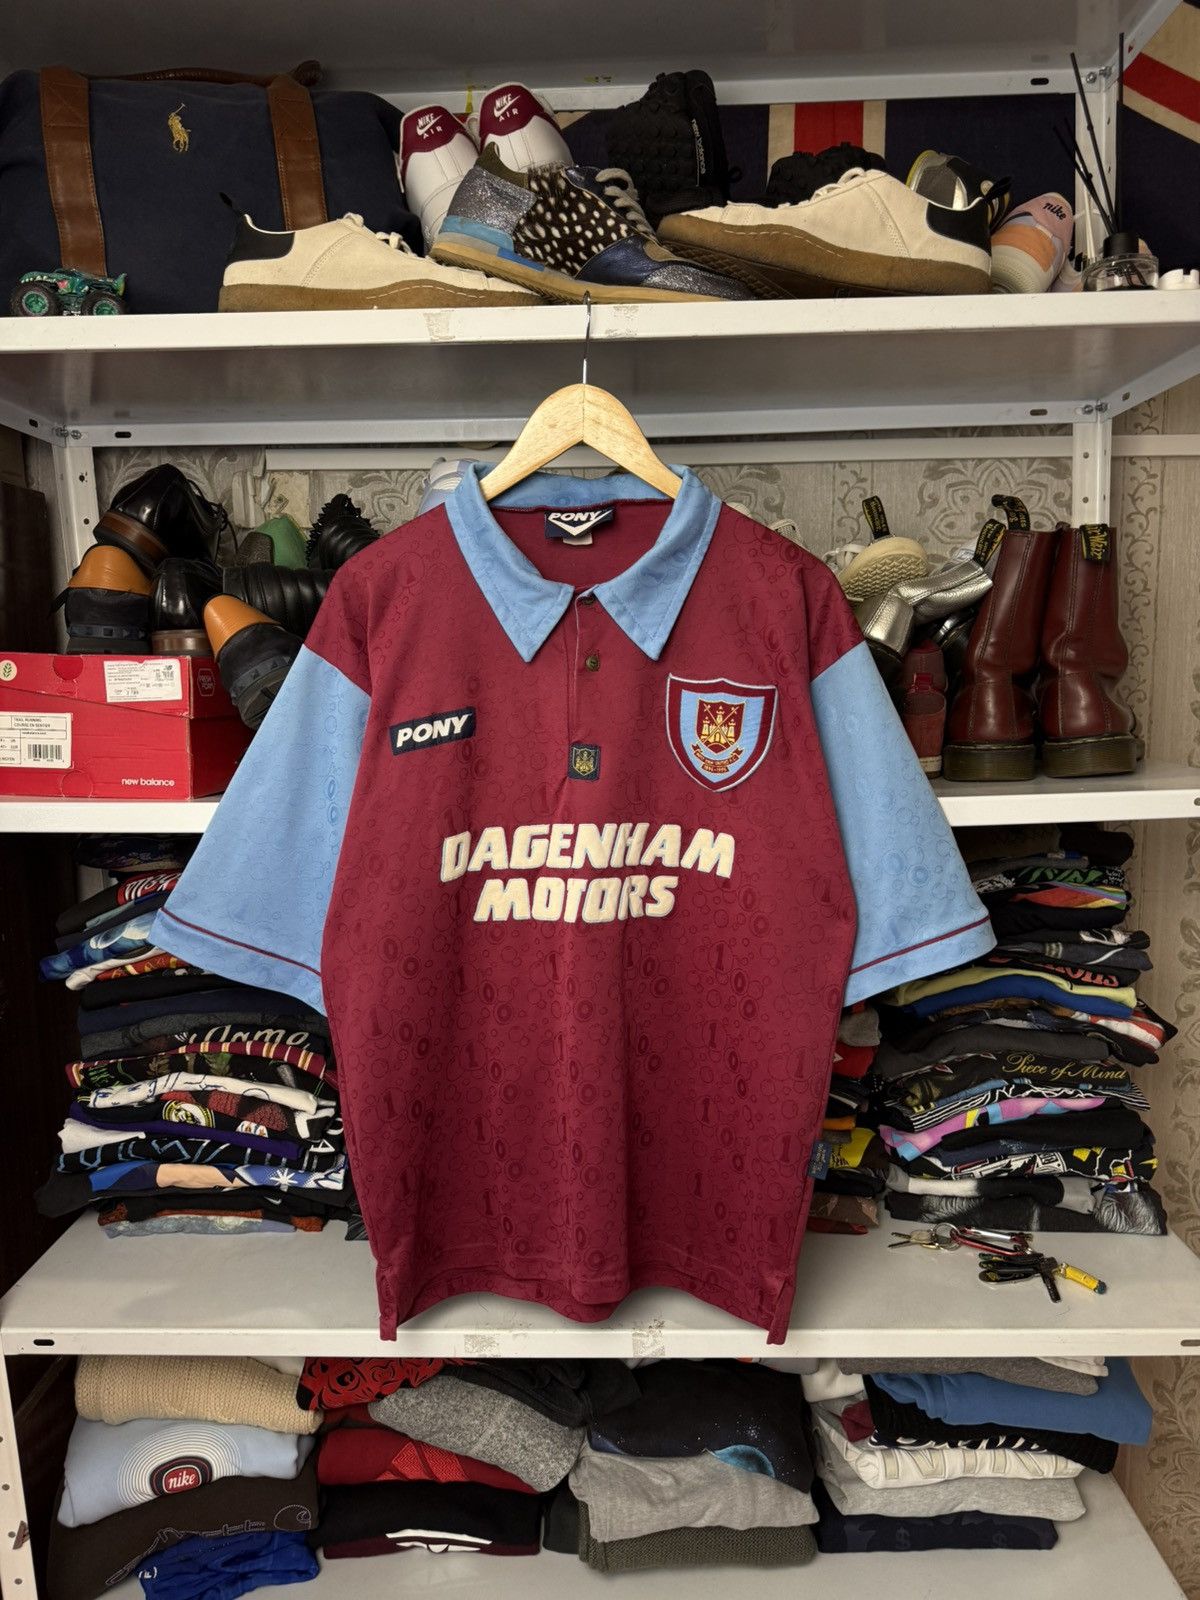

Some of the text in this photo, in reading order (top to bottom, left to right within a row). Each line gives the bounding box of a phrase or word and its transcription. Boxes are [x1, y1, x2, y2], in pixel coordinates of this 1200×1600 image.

[494, 93, 513, 110] NIKE
[416, 113, 434, 127] NIKE
[499, 108, 519, 122] AIR
[423, 126, 442, 139] AIR
[1043, 202, 1066, 220] nike
[547, 510, 602, 521] PONY
[396, 713, 472, 748] PONY
[121, 777, 175, 787] new balance
[440, 822, 735, 883] DAGENHAM
[473, 875, 680, 924] MOTORS
[1002, 1052, 1048, 1075] Piece
[1050, 1062, 1076, 1081] of
[168, 1470, 196, 1489] nike
